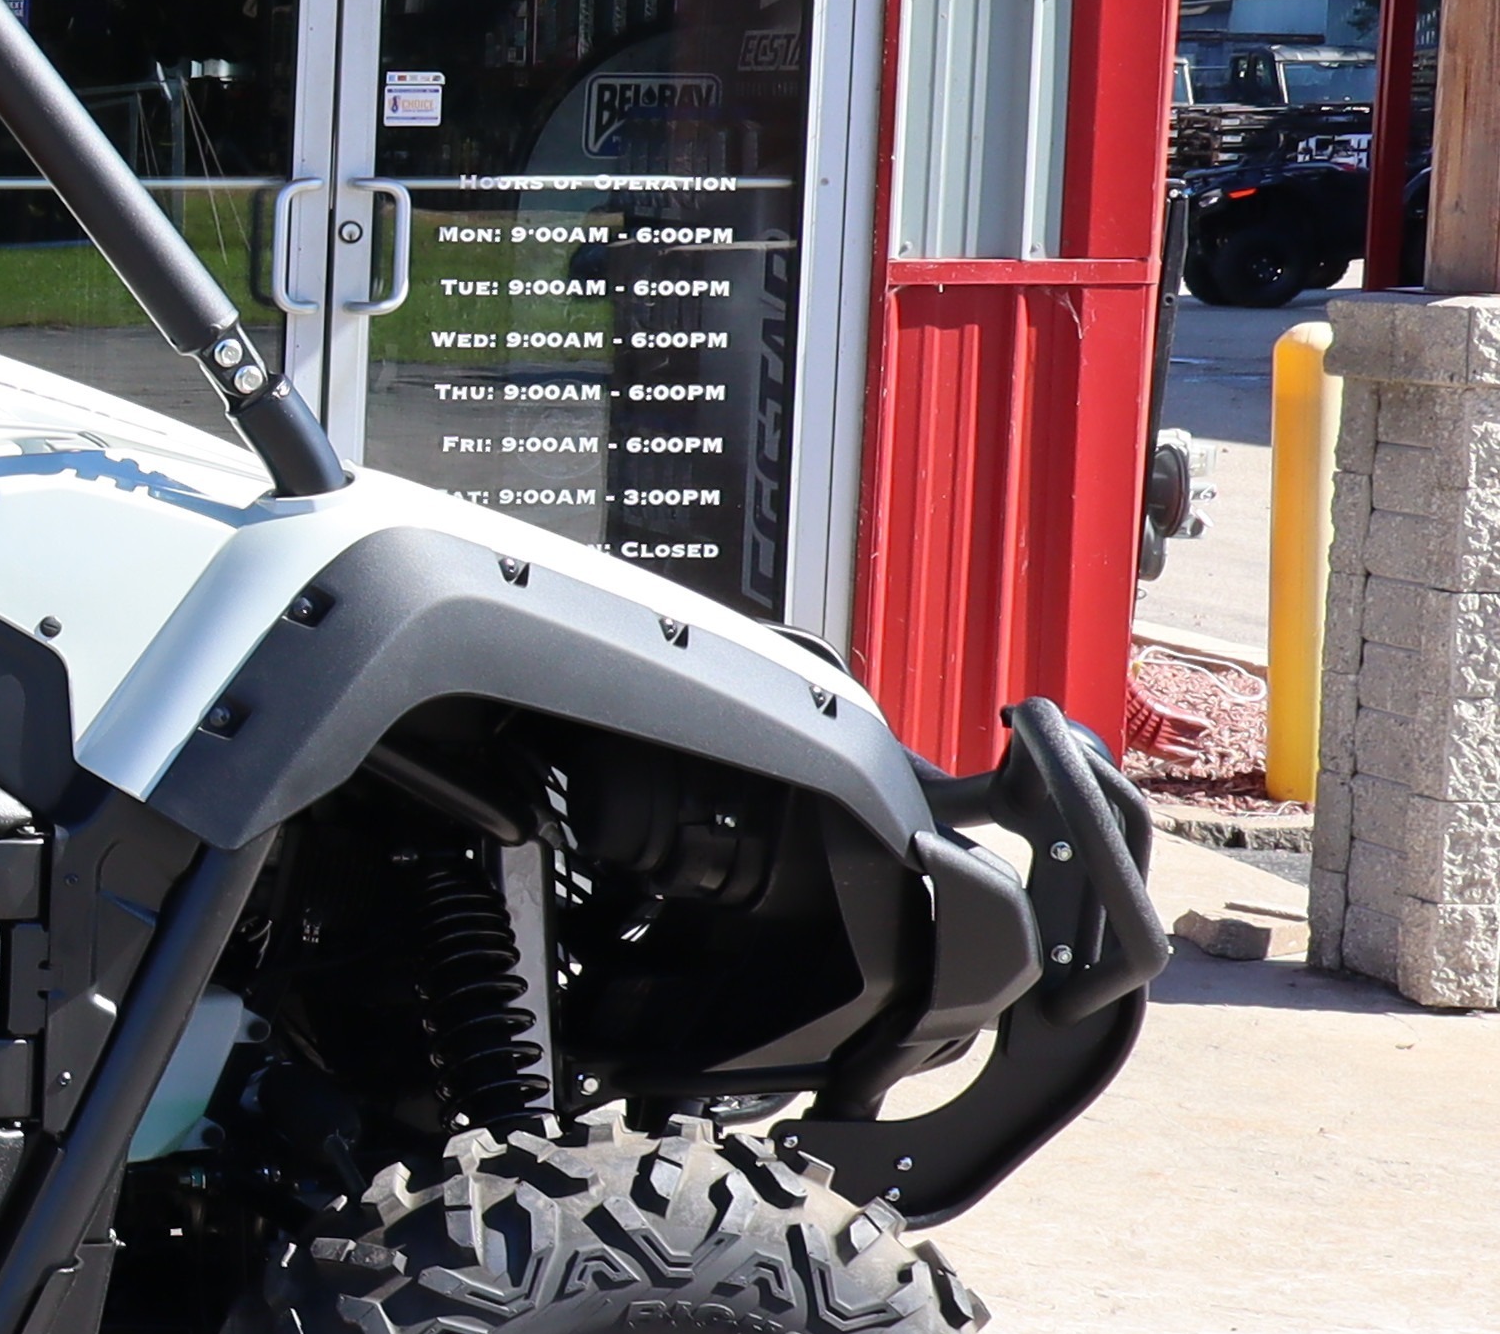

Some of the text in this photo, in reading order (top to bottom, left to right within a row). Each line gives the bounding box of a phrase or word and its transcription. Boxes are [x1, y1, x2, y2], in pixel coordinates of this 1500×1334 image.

[636, 228, 733, 244] 6:00PM
[508, 279, 606, 296] 9:00AM
[633, 280, 730, 297] 6:00PM
[506, 331, 604, 348] 9:00AM
[631, 332, 728, 349] 6:00PM
[503, 384, 601, 401] 9:00AM
[628, 385, 726, 401] 6:00PM
[501, 436, 599, 453] 9:00AM
[626, 437, 723, 454] 6:00PM
[499, 489, 596, 505] 9:00AM
[623, 489, 721, 506] 3:00PM
